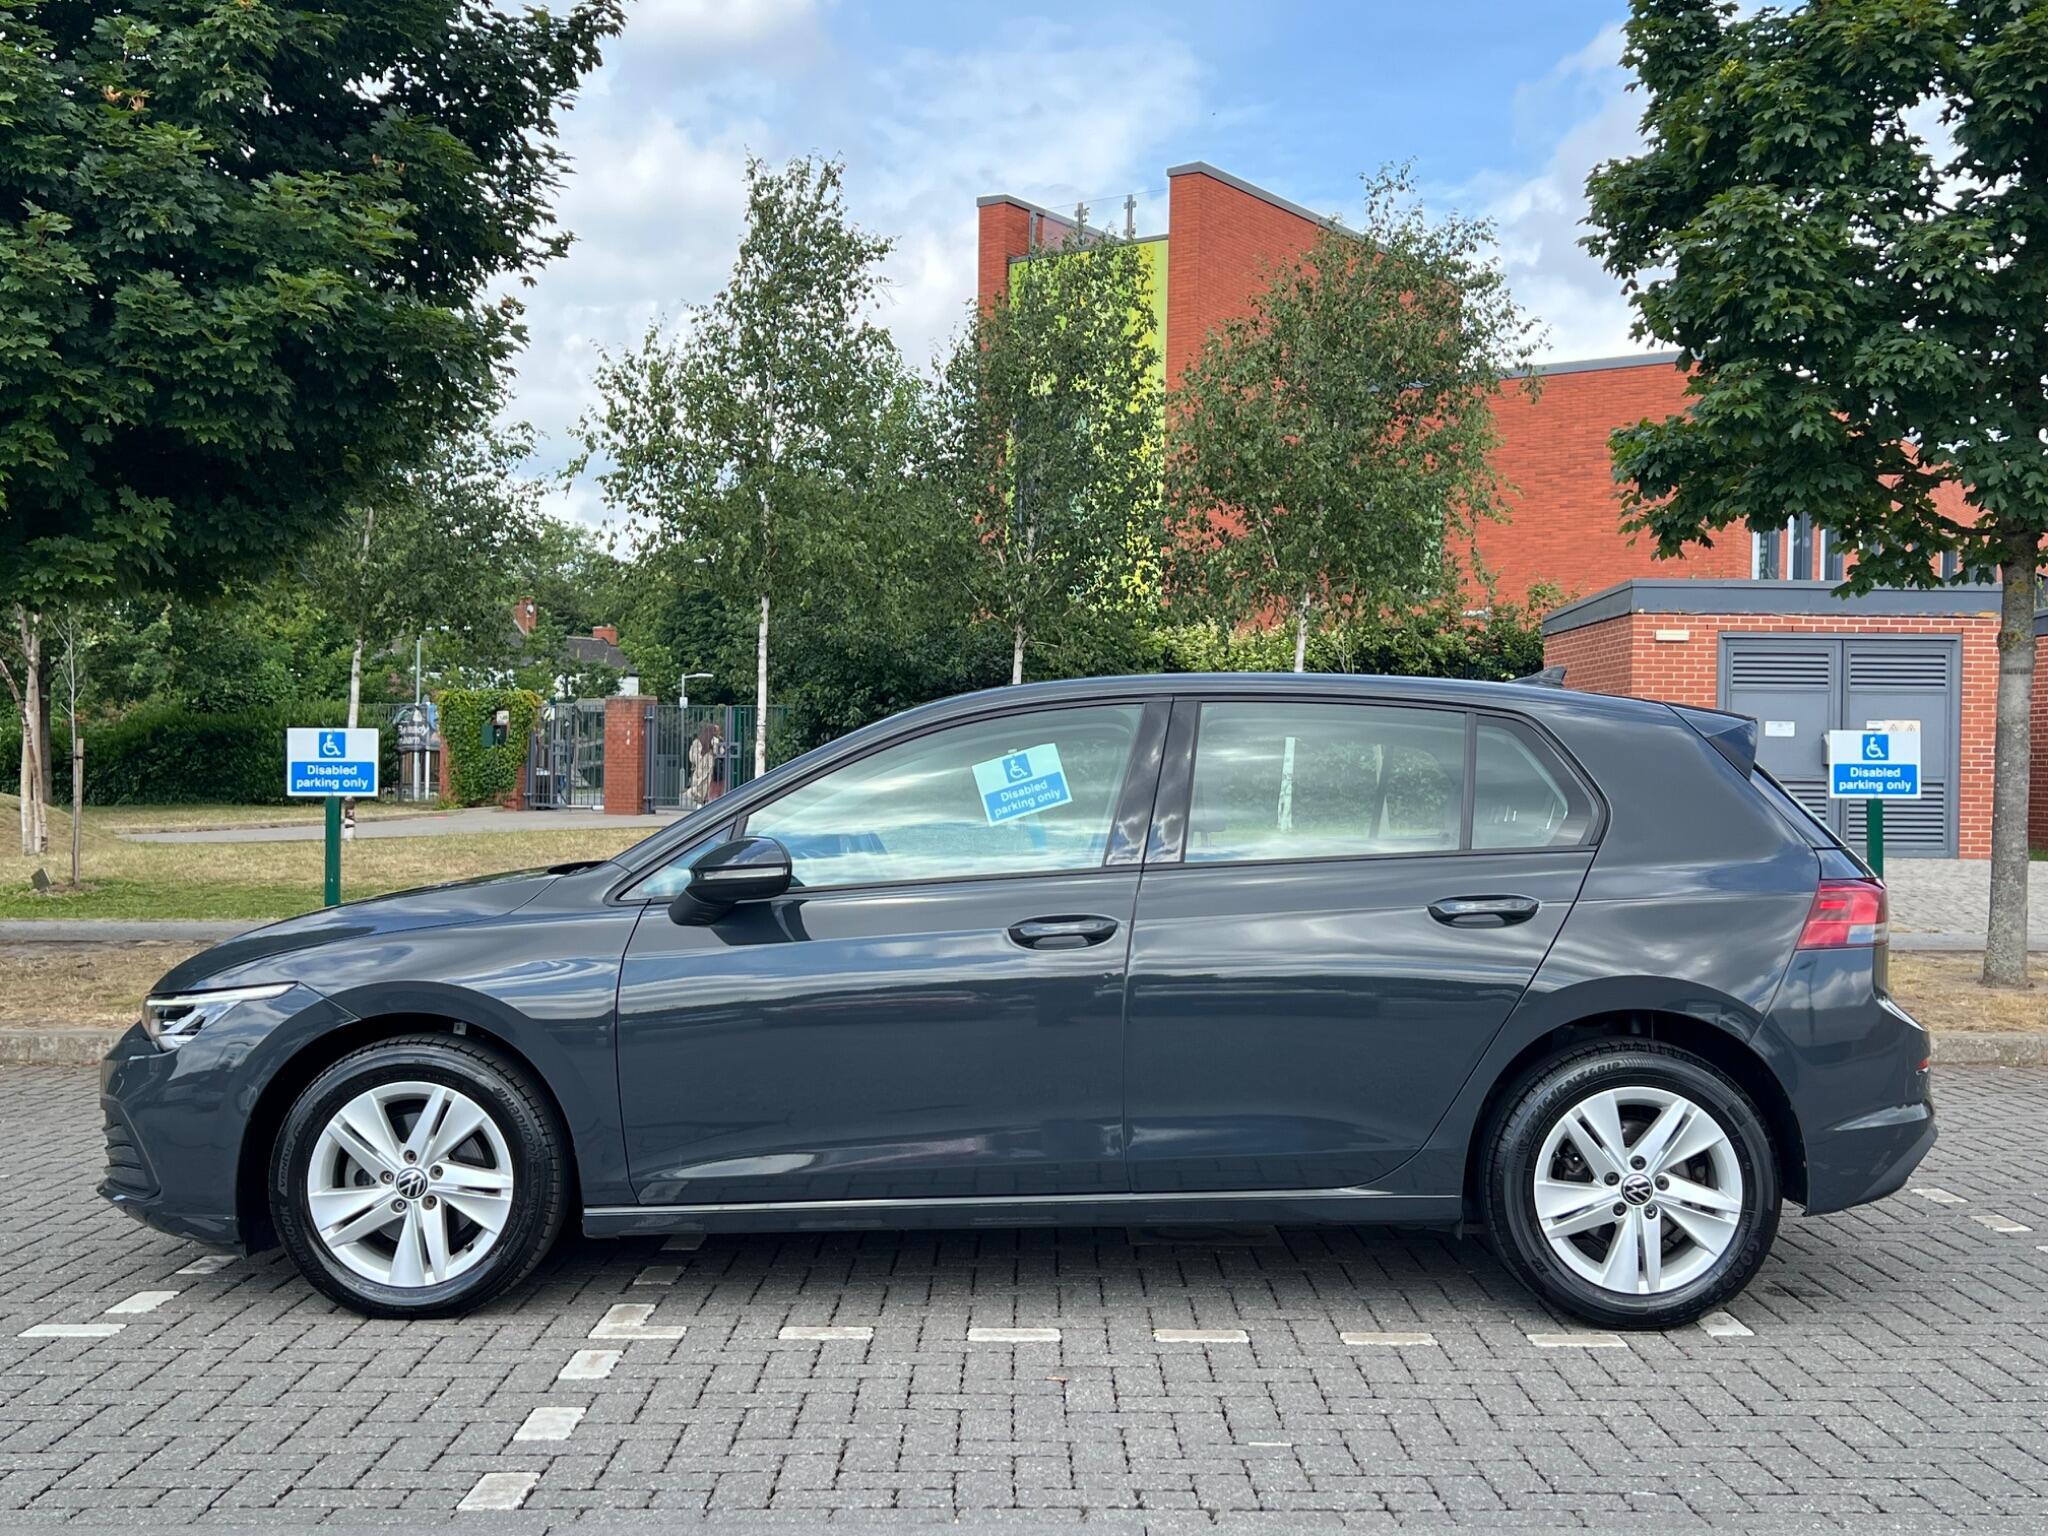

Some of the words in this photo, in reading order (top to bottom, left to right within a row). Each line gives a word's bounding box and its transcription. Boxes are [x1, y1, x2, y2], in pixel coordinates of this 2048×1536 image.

[306, 765, 357, 775] Disabled
[1850, 767, 1901, 778] Disabled
[296, 777, 340, 790] parking
[342, 777, 368, 790] only
[1839, 779, 1884, 792] parking
[1886, 780, 1912, 792] only
[1000, 779, 1048, 802] Disabled
[994, 796, 1036, 818] parking
[1037, 789, 1061, 803] only
